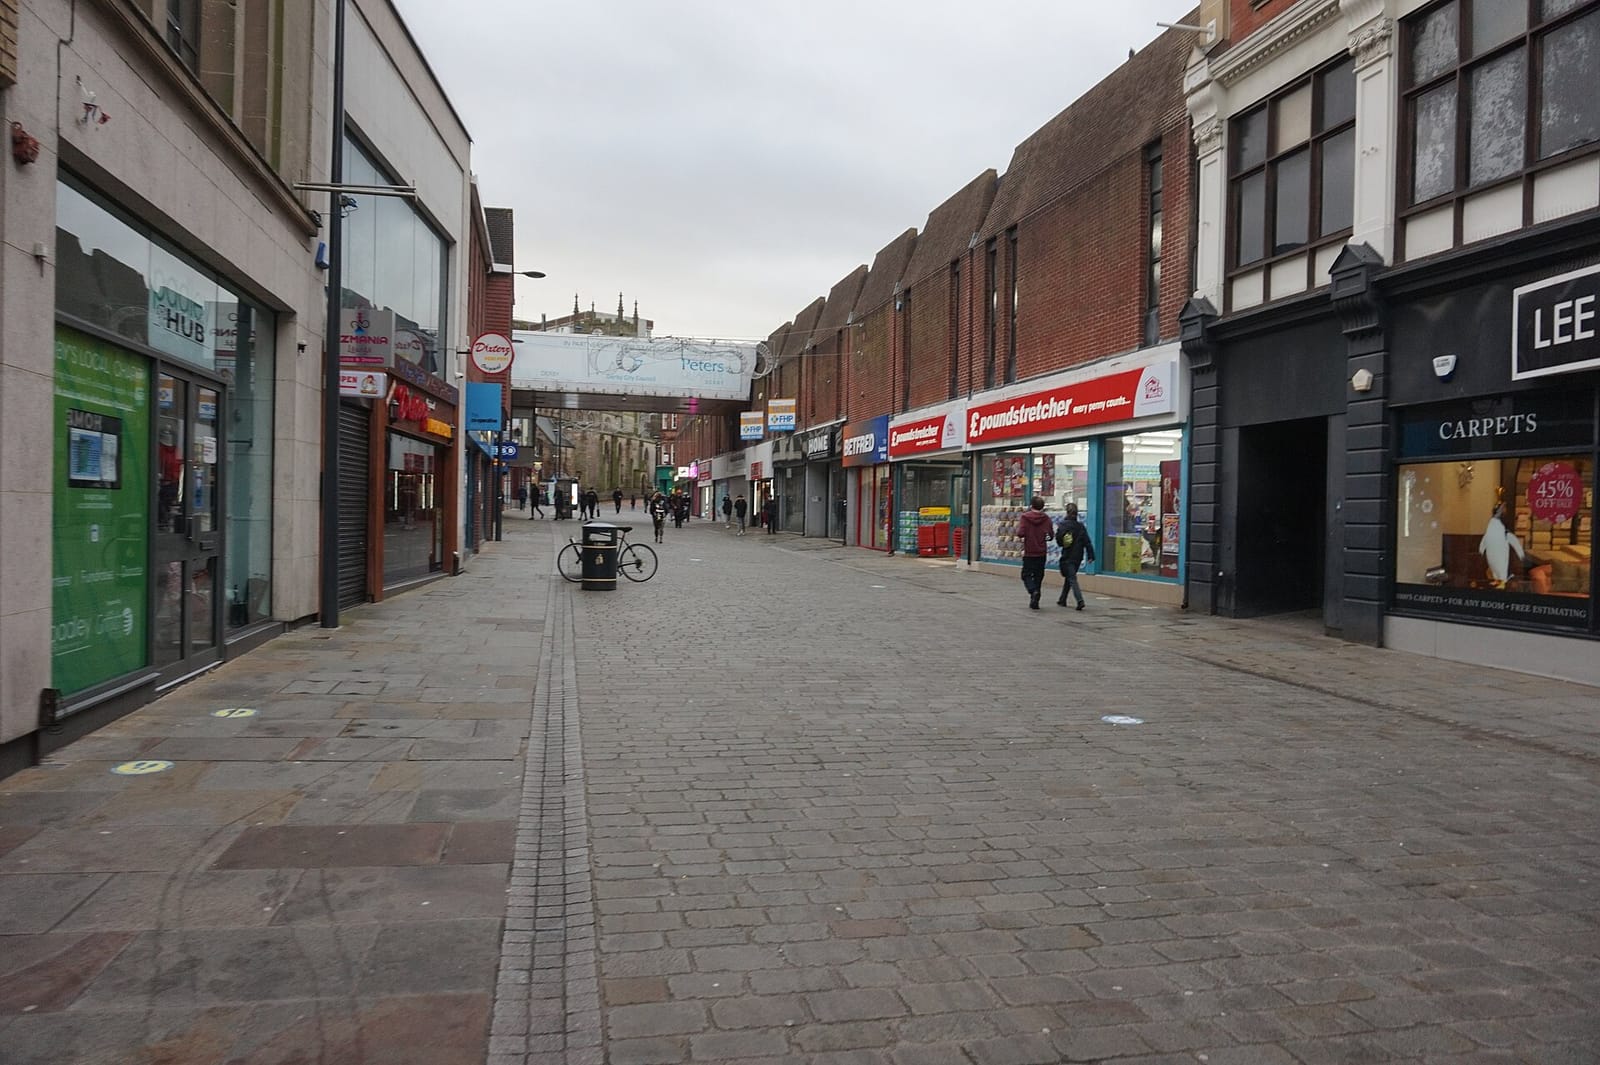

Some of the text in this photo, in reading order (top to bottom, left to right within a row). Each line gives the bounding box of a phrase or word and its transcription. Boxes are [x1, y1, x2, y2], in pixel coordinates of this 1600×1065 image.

[166, 308, 205, 343] HUB
[1534, 295, 1596, 350] LEE
[682, 358, 724, 373] Peters
[779, 415, 793, 423] FHP
[1439, 413, 1537, 440] CARPETS
[808, 434, 828, 454] HOME
[843, 433, 875, 456] BETFRED
[1536, 480, 1574, 497] 45%
[1536, 498, 1554, 508] OFF
[1448, 597, 1463, 606] FOR
[1464, 600, 1479, 608] ANY
[1481, 601, 1505, 610] ROOM
[1510, 603, 1531, 613] FREE
[1532, 606, 1587, 618] ESTIMATING
